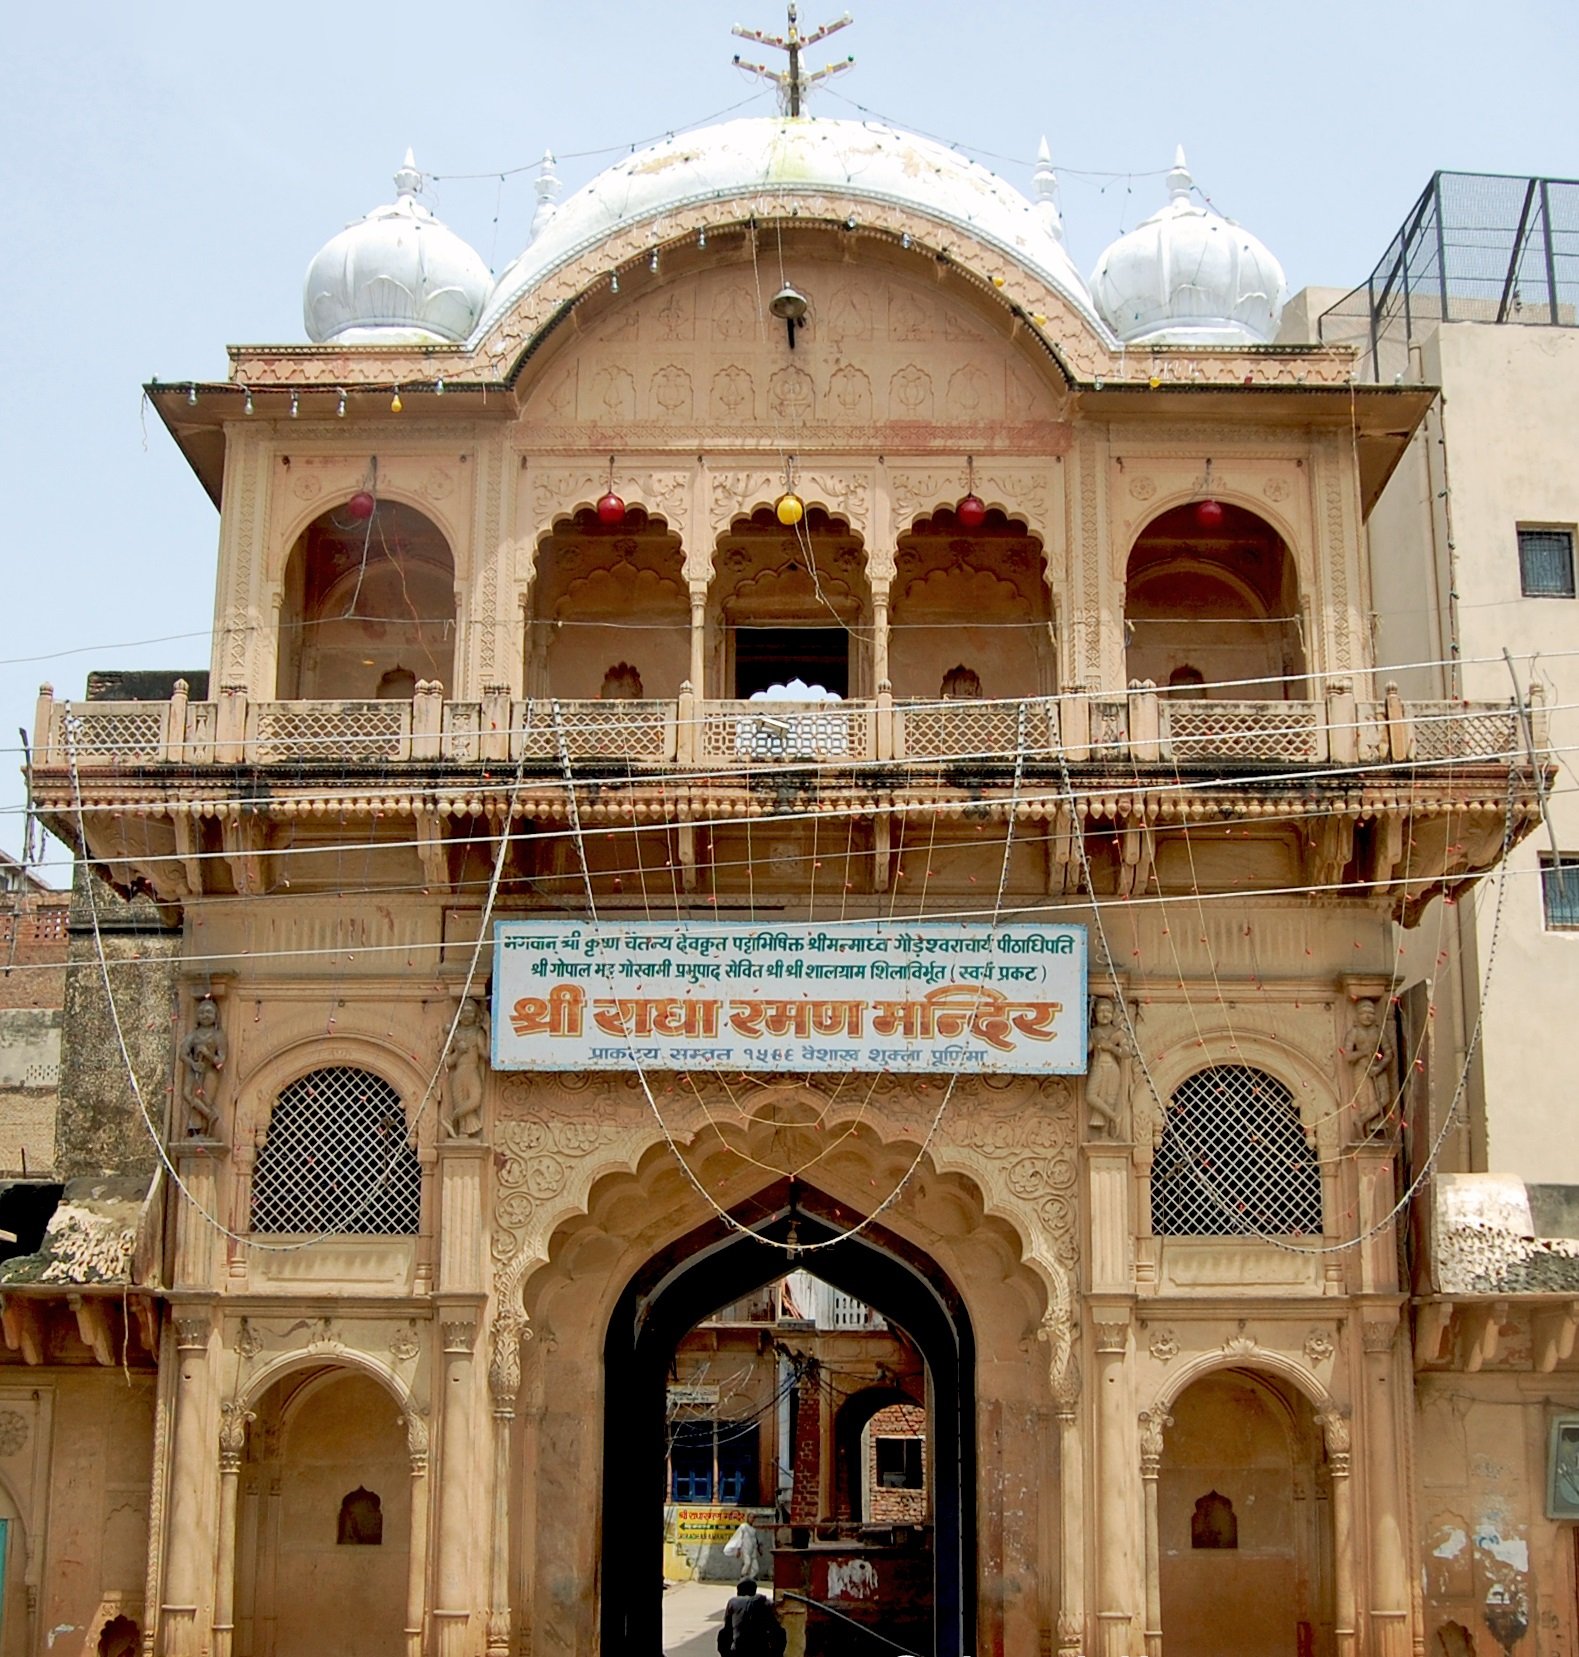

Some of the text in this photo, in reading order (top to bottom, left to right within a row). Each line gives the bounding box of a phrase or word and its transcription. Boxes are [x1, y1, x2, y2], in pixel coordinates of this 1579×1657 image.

[561, 930, 582, 951] श्री
[997, 933, 1076, 955] पीठाधिपति
[530, 957, 549, 978] श्री
[550, 958, 592, 978] गोपाल
[618, 958, 673, 979] गोस्वामी
[675, 962, 722, 984] प्रभुपाद
[725, 959, 764, 979] सेवित
[766, 958, 784, 979] श्री
[785, 958, 804, 979] श्री
[805, 963, 867, 980] शालग्राम
[509, 983, 1063, 1052] श्री राधा रमण मन्दिर
[801, 1045, 861, 1062] वैशाख
